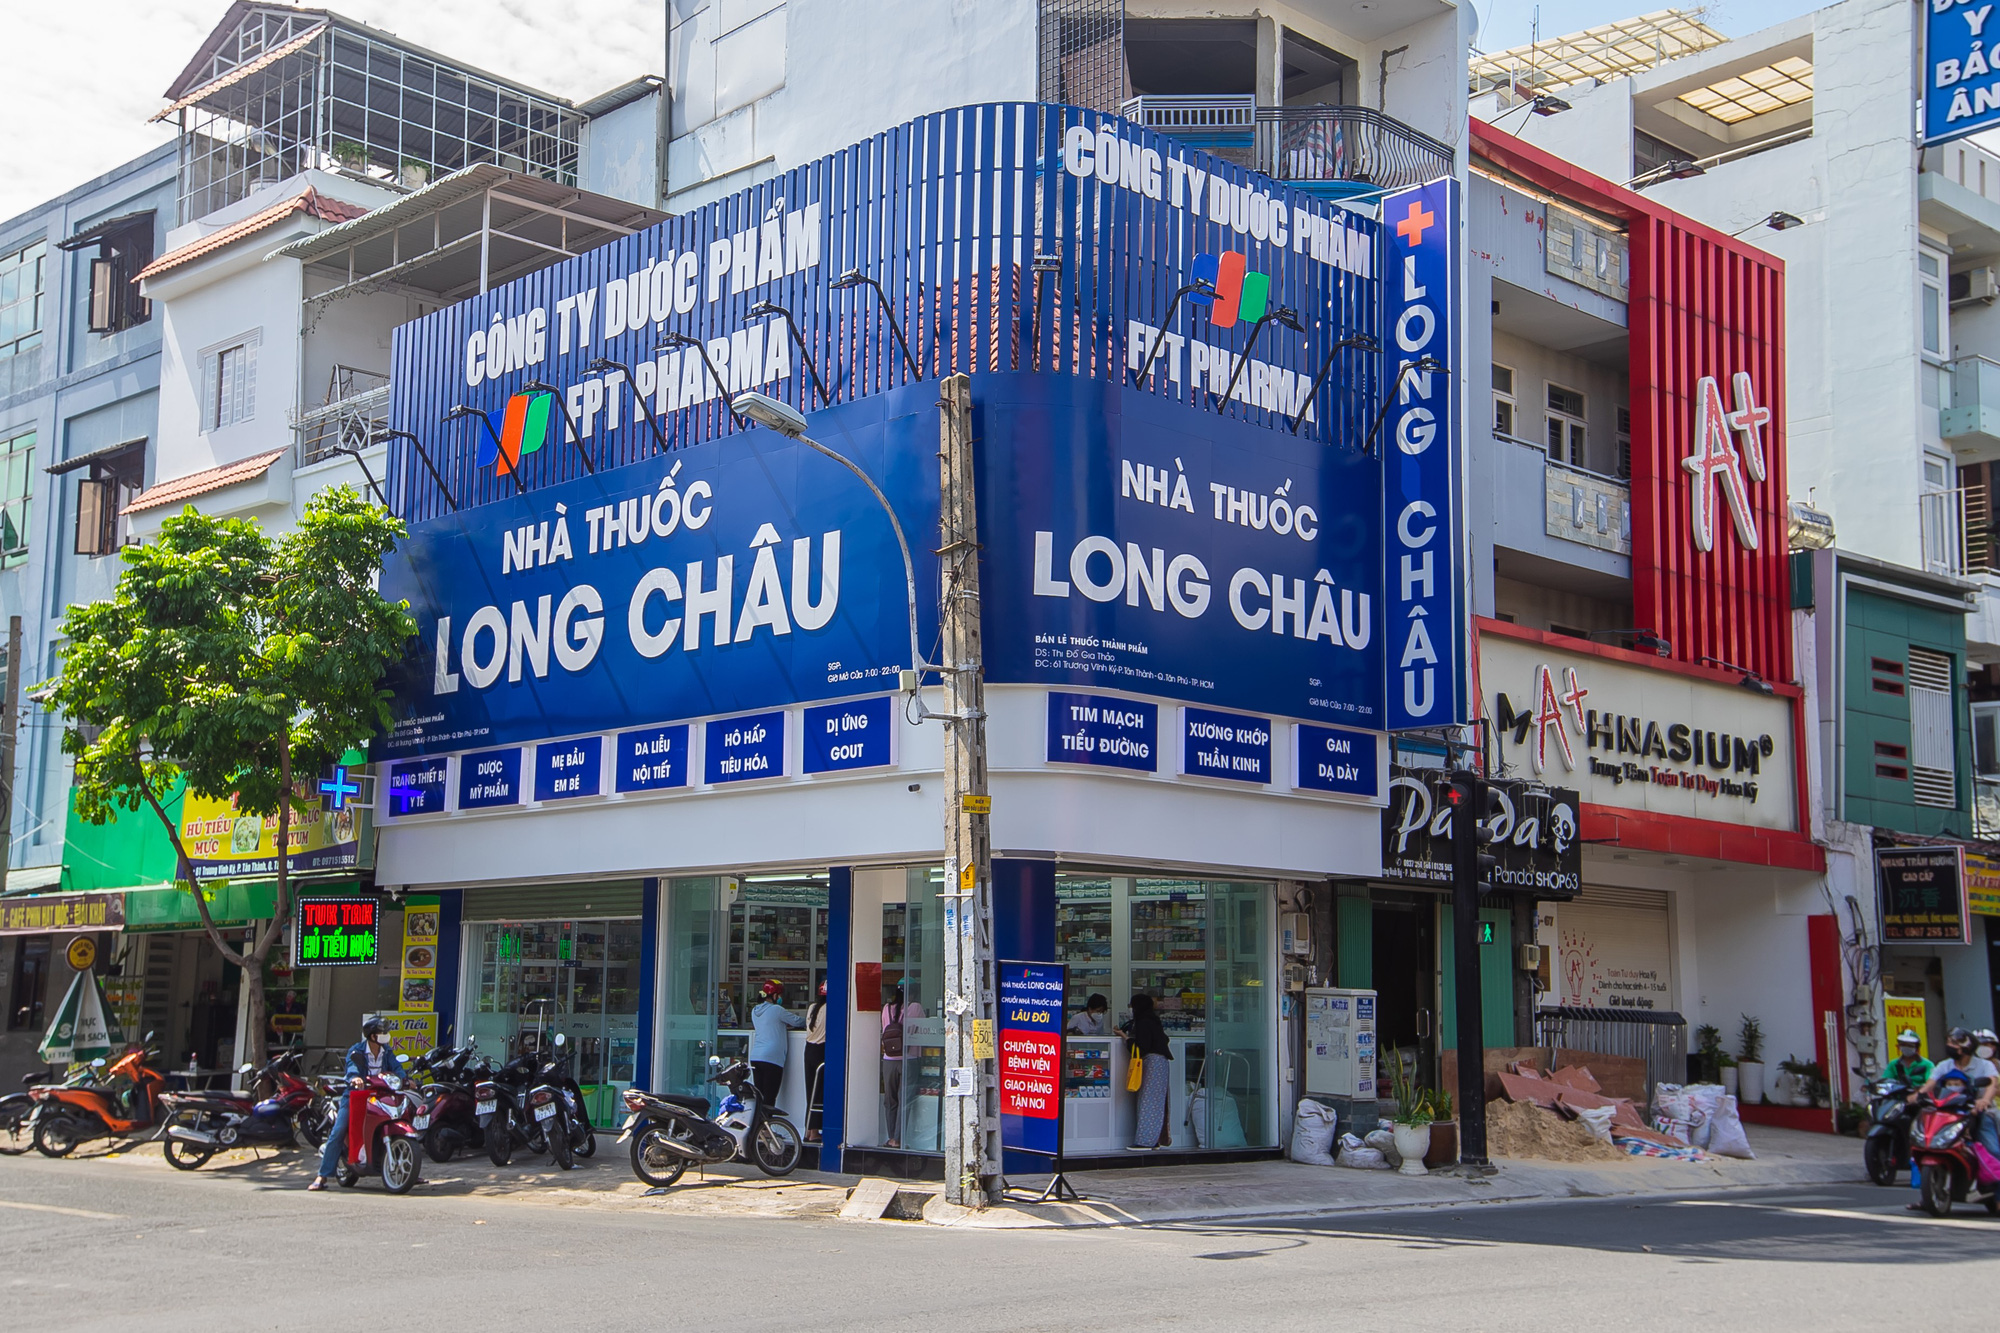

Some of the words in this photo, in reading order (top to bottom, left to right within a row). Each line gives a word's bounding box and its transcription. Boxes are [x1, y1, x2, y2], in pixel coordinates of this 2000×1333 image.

[1962, 4, 1993, 36] Y
[1065, 123, 1162, 201] CÔNG
[1167, 157, 1207, 216] TY
[1209, 178, 1287, 249] DƯỢC
[1293, 207, 1371, 279] PHẨM
[466, 306, 547, 387] CÔNG
[556, 287, 599, 356] TY
[604, 248, 699, 339] DƯỢC
[709, 196, 820, 303] PHẨM
[1395, 255, 1438, 456] LONG
[566, 368, 627, 444] FPT
[634, 315, 791, 423] PHARMA
[1128, 320, 1185, 383] FPT
[1191, 340, 1315, 423] PHARMA
[1122, 456, 1195, 514] NHÀ
[1210, 478, 1318, 542] THUỐC
[502, 502, 572, 575] NHÀ
[586, 460, 713, 554] THUỐC
[1034, 531, 1211, 619] LONG
[1229, 568, 1371, 651] CHÂU
[434, 584, 605, 696] LONG
[628, 522, 842, 658] CHÂU
[1397, 500, 1438, 718] CHÂU
[1035, 633, 1055, 644] BÁN
[1058, 634, 1067, 644] LẺ
[1070, 636, 1099, 647] THUỐC
[1102, 638, 1126, 651] THÀNH
[1128, 642, 1148, 654] PHẨM
[1035, 648, 1050, 657] DS:
[1081, 651, 1095, 659] Gia
[1097, 652, 1115, 662] Thảo
[1035, 659, 1052, 668] ĐC:
[1053, 660, 1061, 668] 61
[1063, 661, 1089, 672] Trương
[1091, 662, 1107, 672] Vĩnh
[827, 674, 838, 683] Giờ
[839, 671, 849, 681] Mở
[850, 670, 863, 680] Cửa
[1309, 698, 1319, 706] Giờ
[1320, 699, 1328, 708] Mở
[826, 718, 838, 736] DỊ
[842, 714, 868, 732] ỨNG
[1070, 706, 1098, 724] TIM
[1102, 711, 1144, 730] MẠCH
[725, 728, 742, 747] HÔ
[744, 724, 766, 744] HẤP
[1062, 729, 1094, 752] TIỂU
[1098, 734, 1149, 759] ĐƯỜNG
[1190, 721, 1234, 742] XƯƠNG
[1236, 724, 1269, 746] KHỚP
[635, 742, 648, 756] DA
[650, 734, 670, 754] LIỄU
[830, 743, 864, 760] GOUT
[1326, 738, 1350, 754] GAN
[478, 760, 503, 777] DƯỢC
[552, 755, 564, 770] MẸ
[566, 747, 584, 766] BẦU
[720, 756, 742, 774] TIÊU
[744, 753, 768, 772] HÓA
[1198, 747, 1229, 770] THẦN
[1232, 757, 1260, 774] KINH
[392, 773, 416, 788] TRANG
[418, 767, 437, 784] THIẾT
[438, 770, 446, 784] BỊ
[633, 766, 651, 784] NỘI
[653, 759, 671, 779] TIẾT
[1318, 764, 1334, 782] DẠ
[1336, 764, 1359, 782] DÀY
[1590, 756, 1623, 784] Trung
[1623, 762, 1650, 782] Tâm
[1650, 766, 1678, 786] Toán
[1680, 771, 1694, 790] Tư
[1697, 774, 1720, 798] Duy
[1720, 778, 1742, 796] Hoa
[470, 784, 482, 799] MỸ
[484, 778, 509, 798] PHẨM
[554, 778, 567, 792] EM
[569, 774, 580, 790] BÉ
[410, 796, 416, 808] Y
[416, 791, 426, 807] TẾ
[186, 818, 203, 836] HỦ
[204, 814, 232, 834] TIẾU
[1390, 777, 1539, 853] Pada
[194, 840, 219, 858] MỰC
[1495, 866, 1534, 886] Panda
[1536, 872, 1578, 890] SHOP63
[304, 904, 338, 926] TUK
[341, 904, 373, 924] TAK
[246, 929, 253, 939] 61
[303, 927, 320, 958] HỦ
[322, 926, 348, 958] TIẾU
[350, 930, 374, 962] MỰC
[1012, 981, 1027, 989] THUỐC
[1028, 982, 1044, 990] LONG
[1046, 980, 1062, 991] CHÂU
[1002, 995, 1018, 1004] CHUỖI
[1031, 998, 1050, 1006] THUỐC
[402, 1017, 428, 1030] Tiếu
[1012, 1008, 1030, 1022] LÂU
[1032, 1010, 1050, 1023] ĐỜI
[1004, 1040, 1036, 1054] CHUYÊN
[1038, 1044, 1056, 1056] TOA
[1008, 1054, 1030, 1071] BỆNH
[1031, 1057, 1050, 1074] VIỆN
[1004, 1079, 1026, 1092] GIAO
[1027, 1079, 1052, 1094] HÀNG
[1010, 1093, 1028, 1110] TẬN
[1029, 1098, 1045, 1110] NƠI
